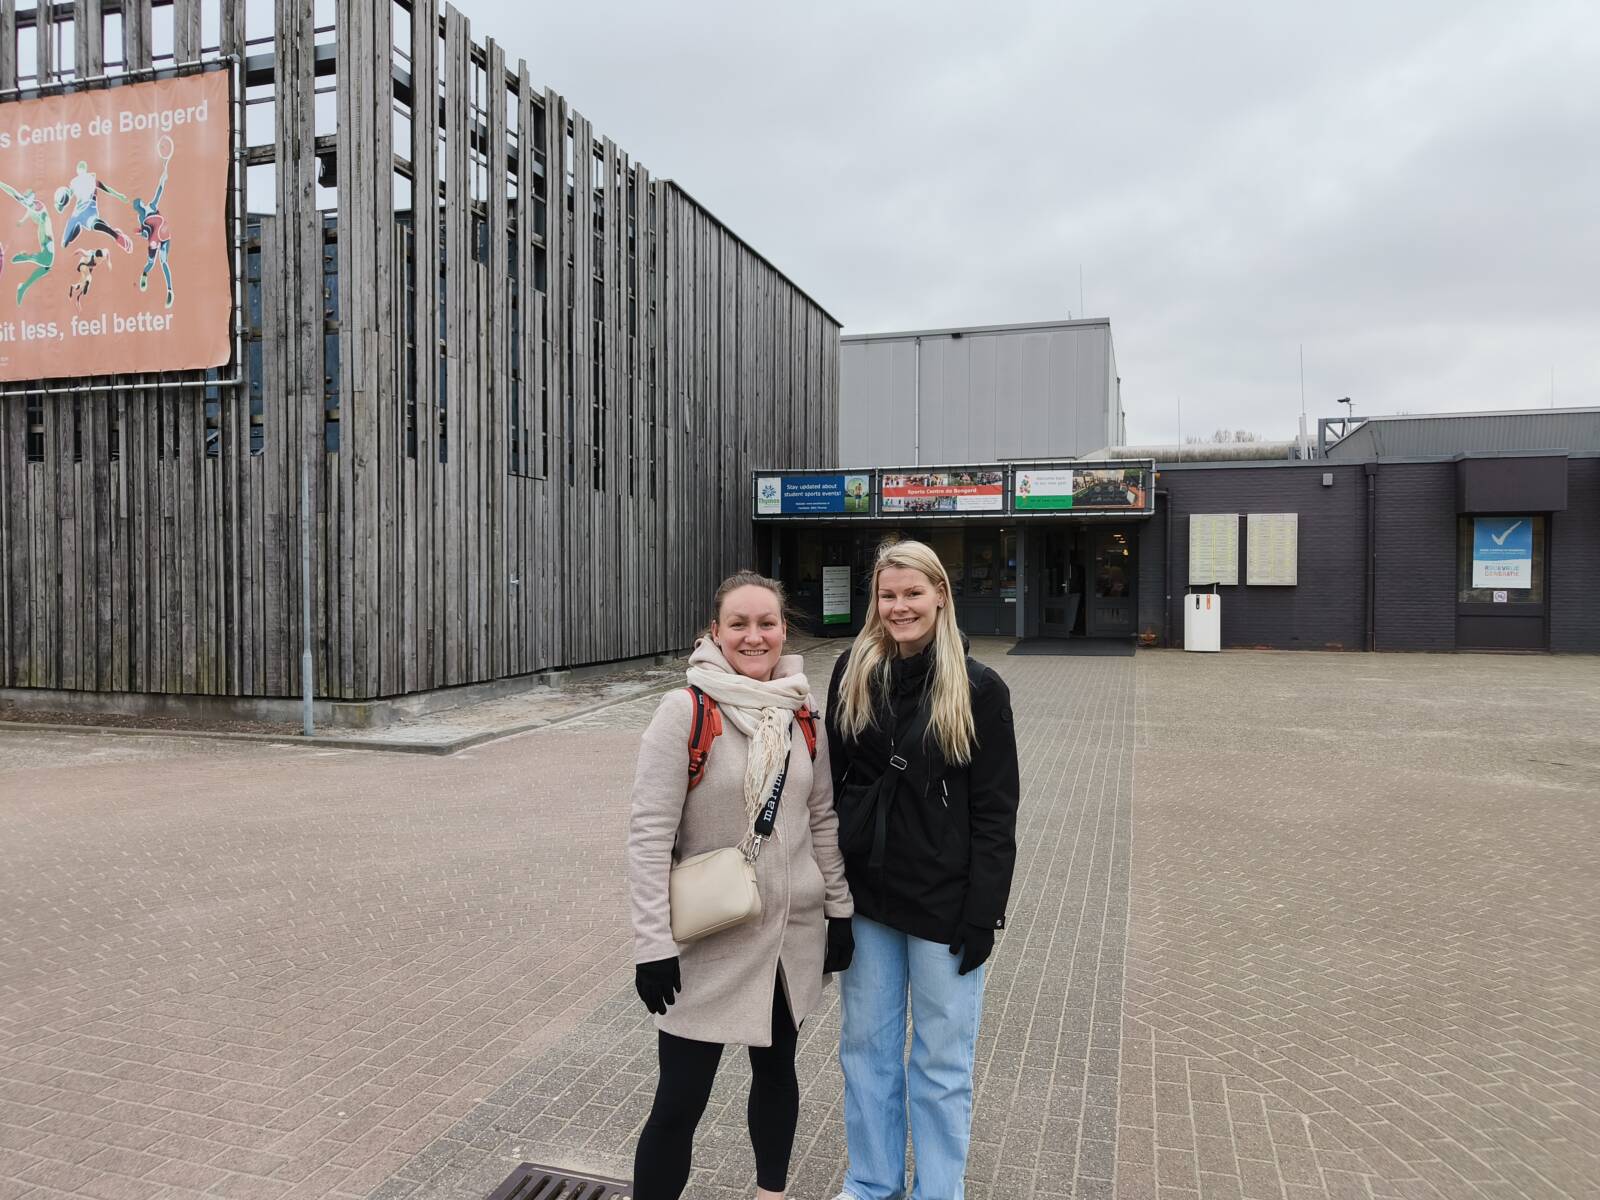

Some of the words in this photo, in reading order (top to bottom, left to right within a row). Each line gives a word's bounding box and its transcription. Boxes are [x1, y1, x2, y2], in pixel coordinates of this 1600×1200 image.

[17, 121, 81, 146] Centre
[88, 115, 113, 137] de
[119, 99, 208, 132] Bongerd
[21, 320, 64, 341] less,
[71, 313, 107, 337] feel
[113, 311, 173, 333] better
[784, 490, 804, 498] student
[953, 487, 977, 495] Bongerd
